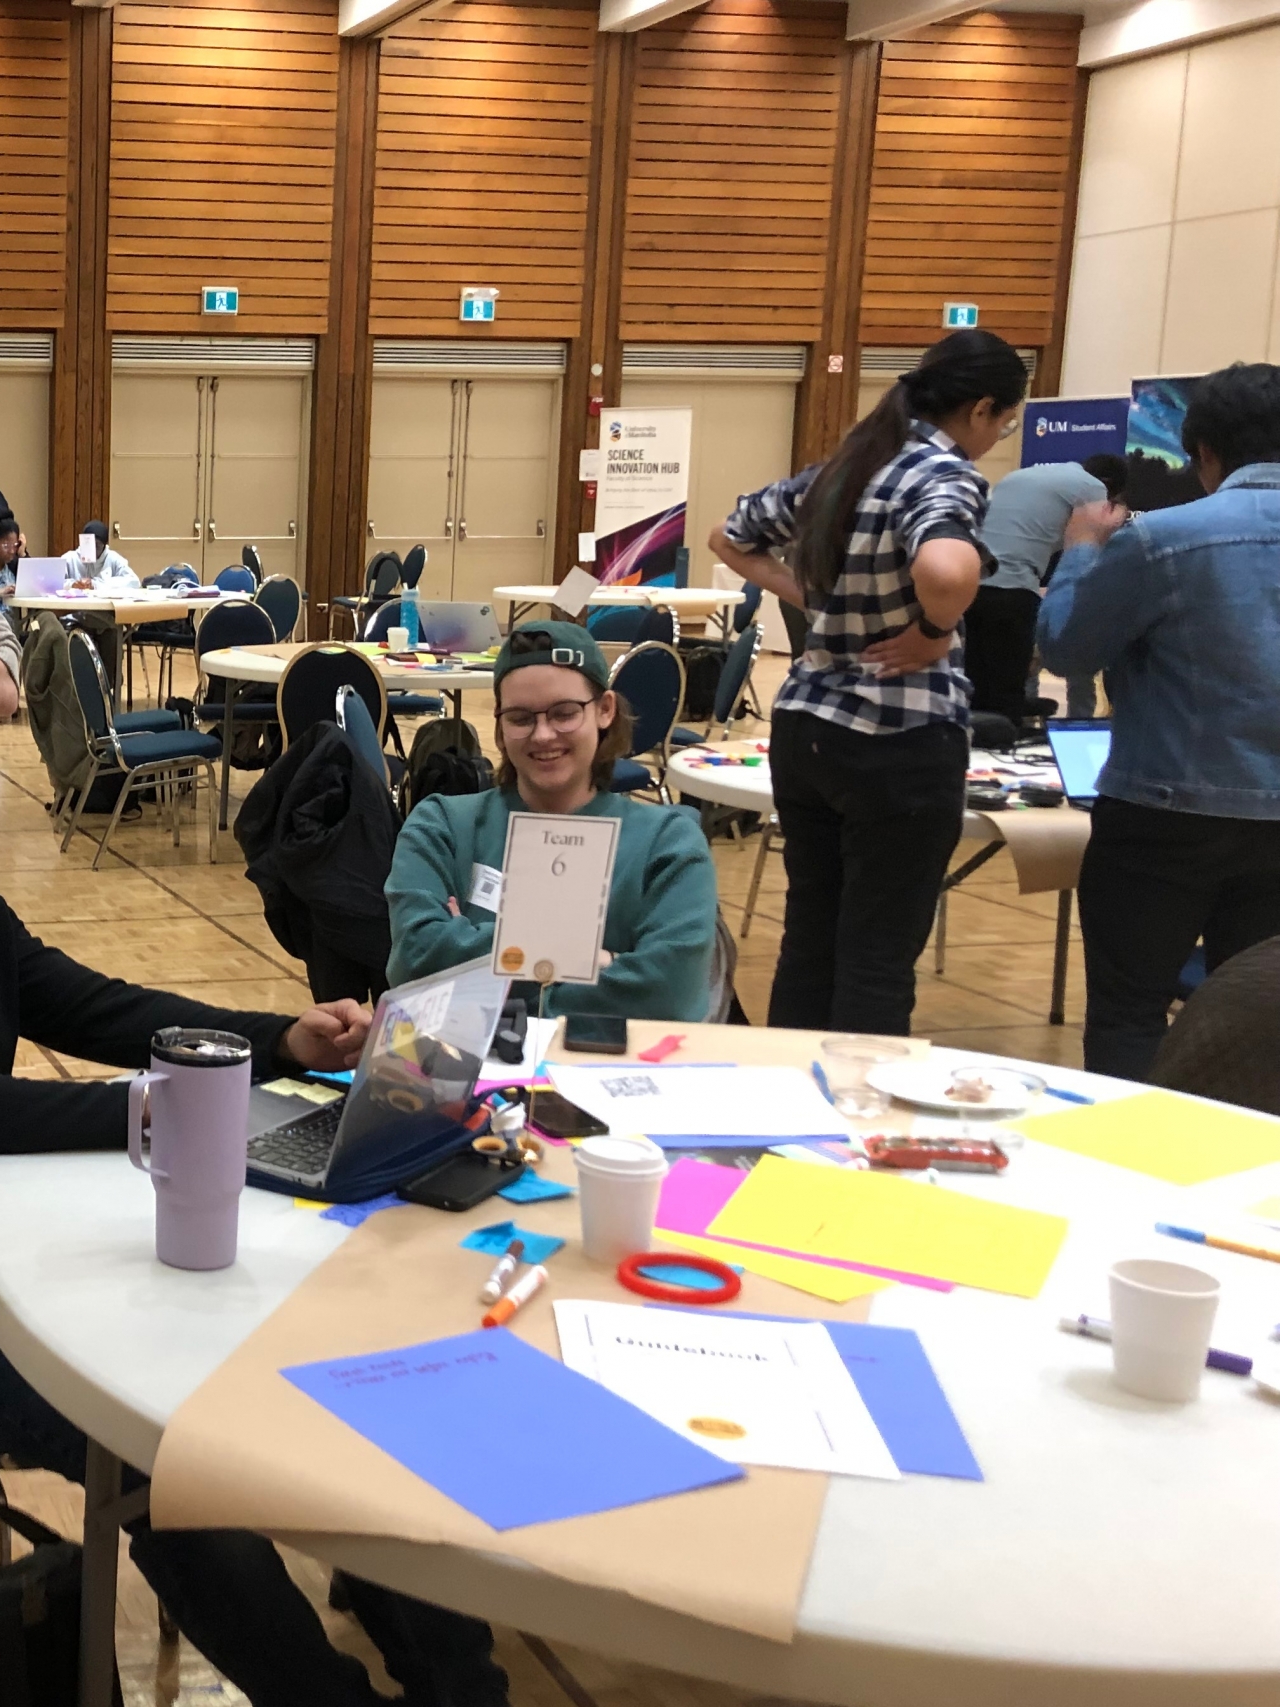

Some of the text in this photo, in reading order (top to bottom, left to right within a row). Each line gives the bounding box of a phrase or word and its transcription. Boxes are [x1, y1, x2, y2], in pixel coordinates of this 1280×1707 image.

[1049, 421, 1067, 432] UM
[607, 449, 644, 461] SCIENCE
[607, 462, 680, 474] INNOVATION HUB
[542, 830, 585, 847] Team
[551, 852, 567, 876] 6
